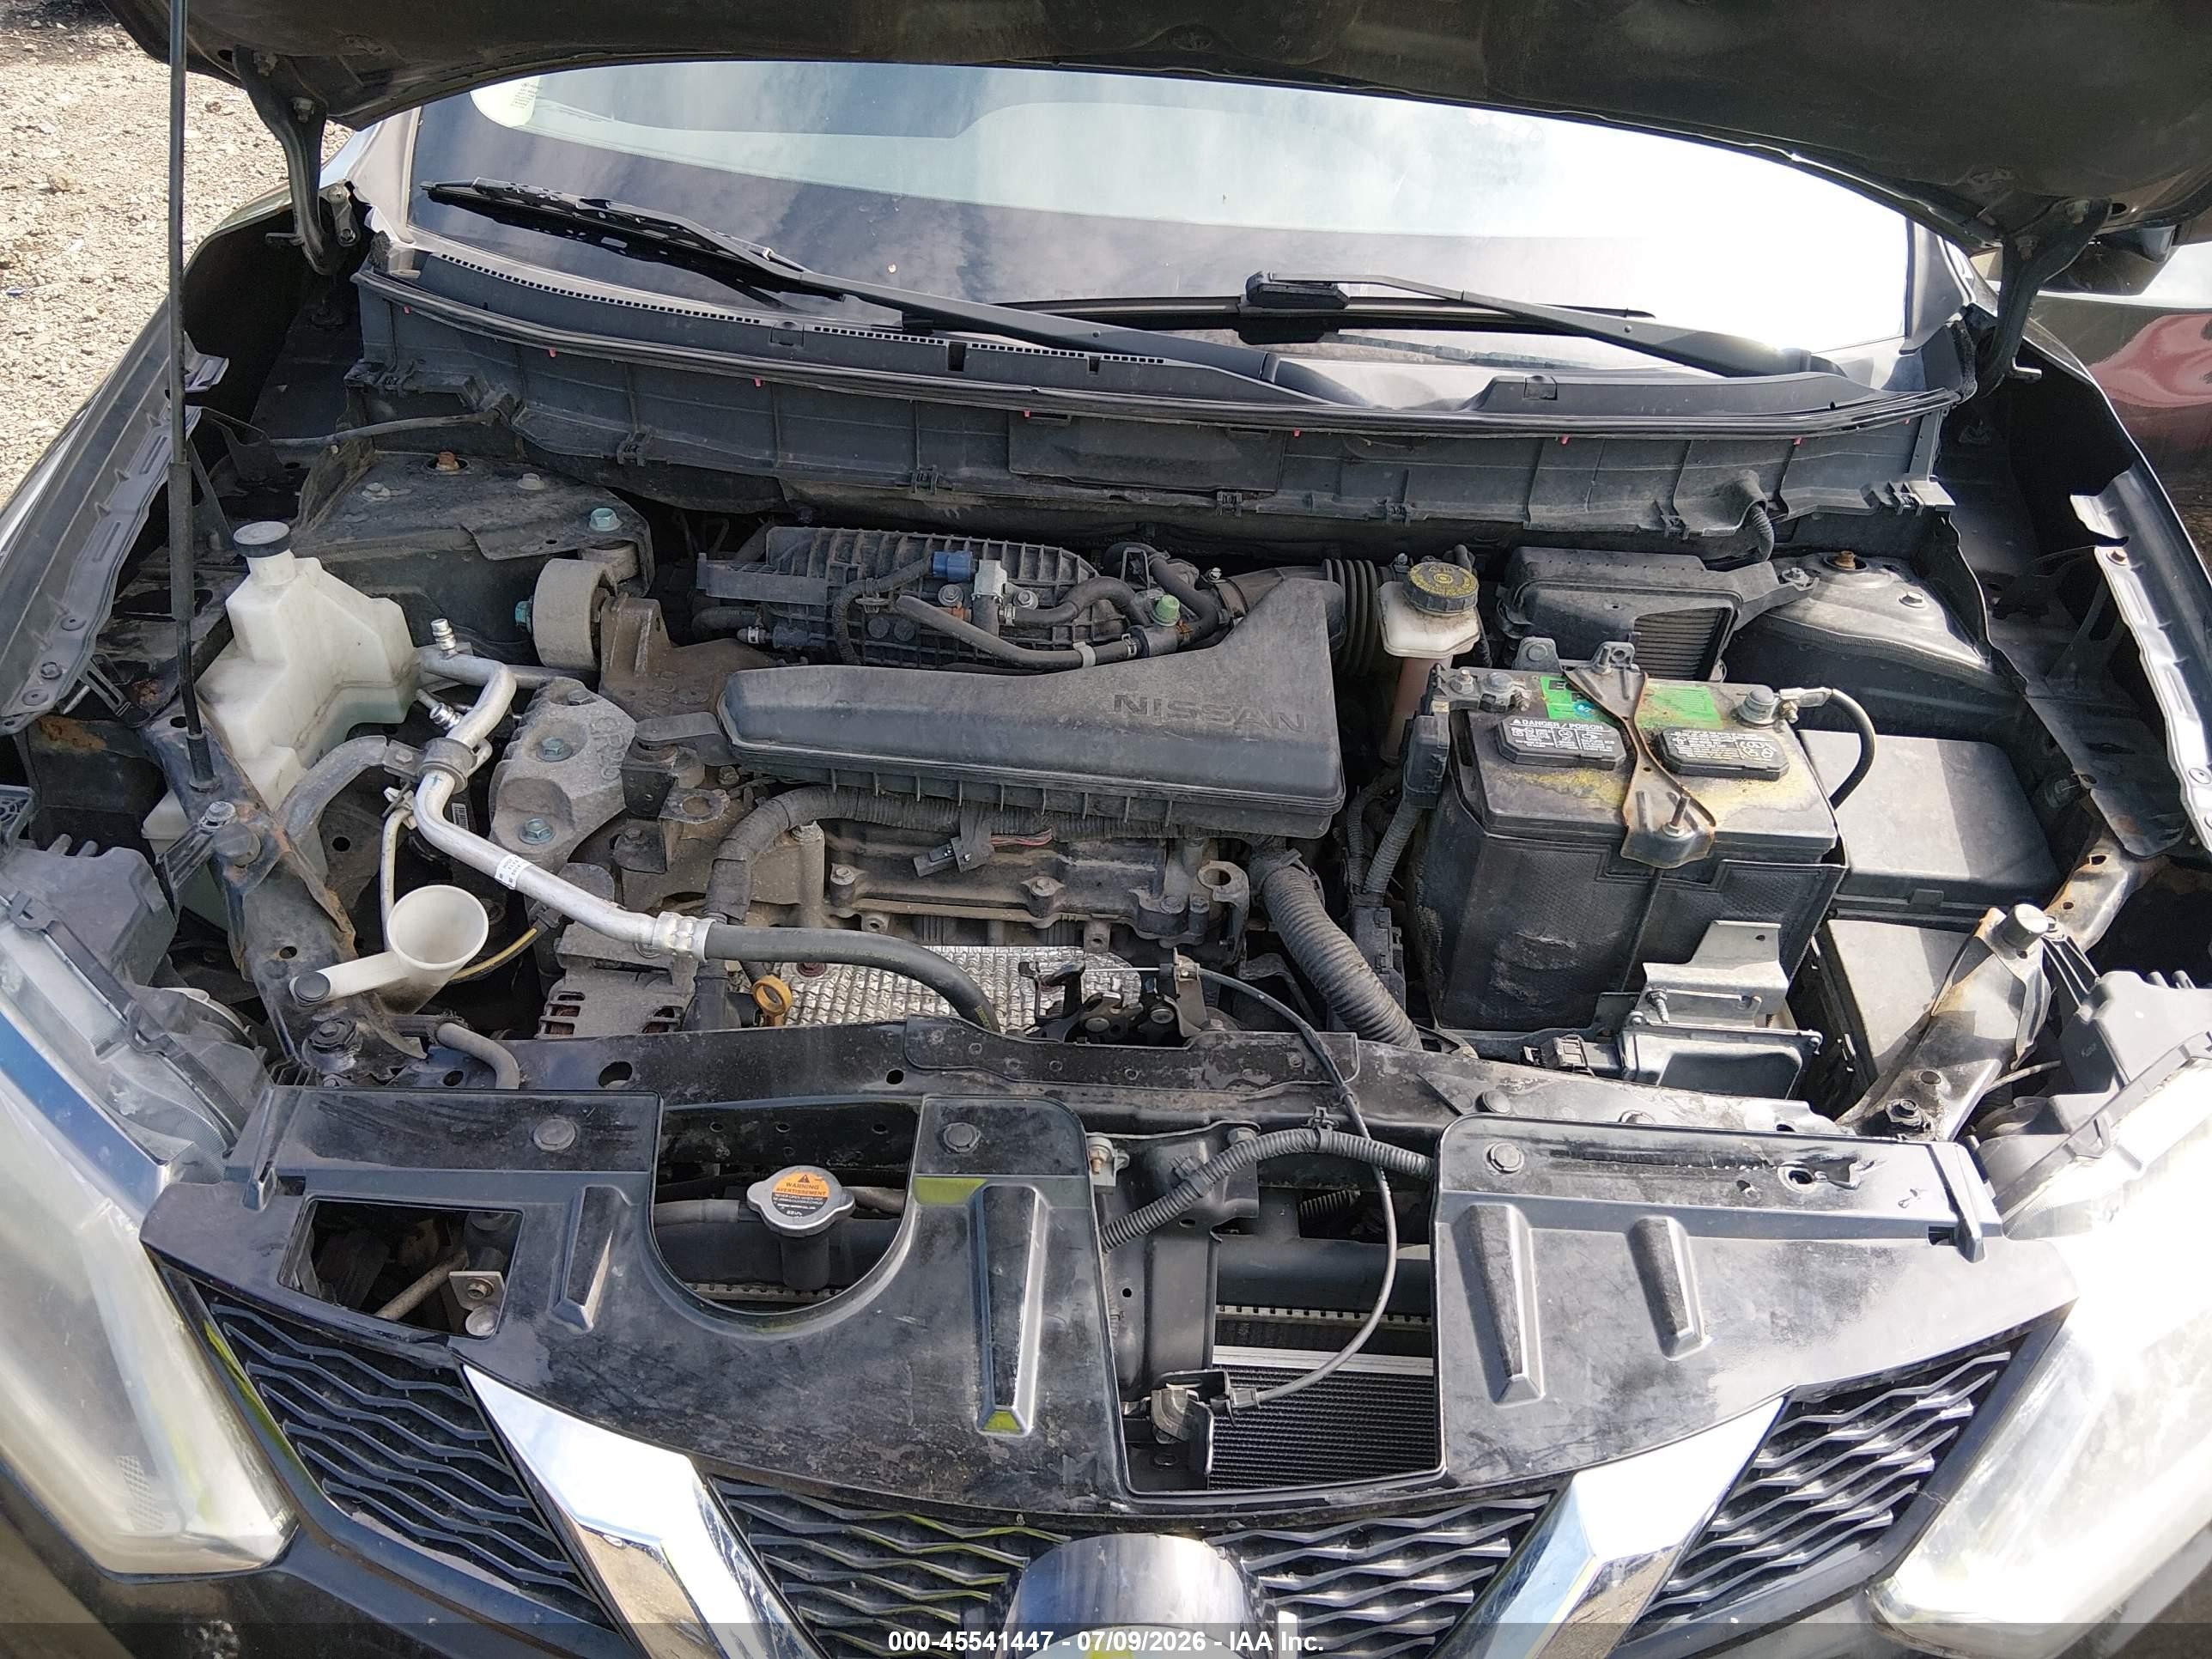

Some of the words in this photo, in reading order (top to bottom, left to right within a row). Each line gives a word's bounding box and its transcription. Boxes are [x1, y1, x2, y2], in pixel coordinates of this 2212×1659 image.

[1113, 694, 1307, 732] NISSAN
[1522, 720, 1560, 728] DANGER
[776, 1188, 826, 1196] AVERTISSEMENT
